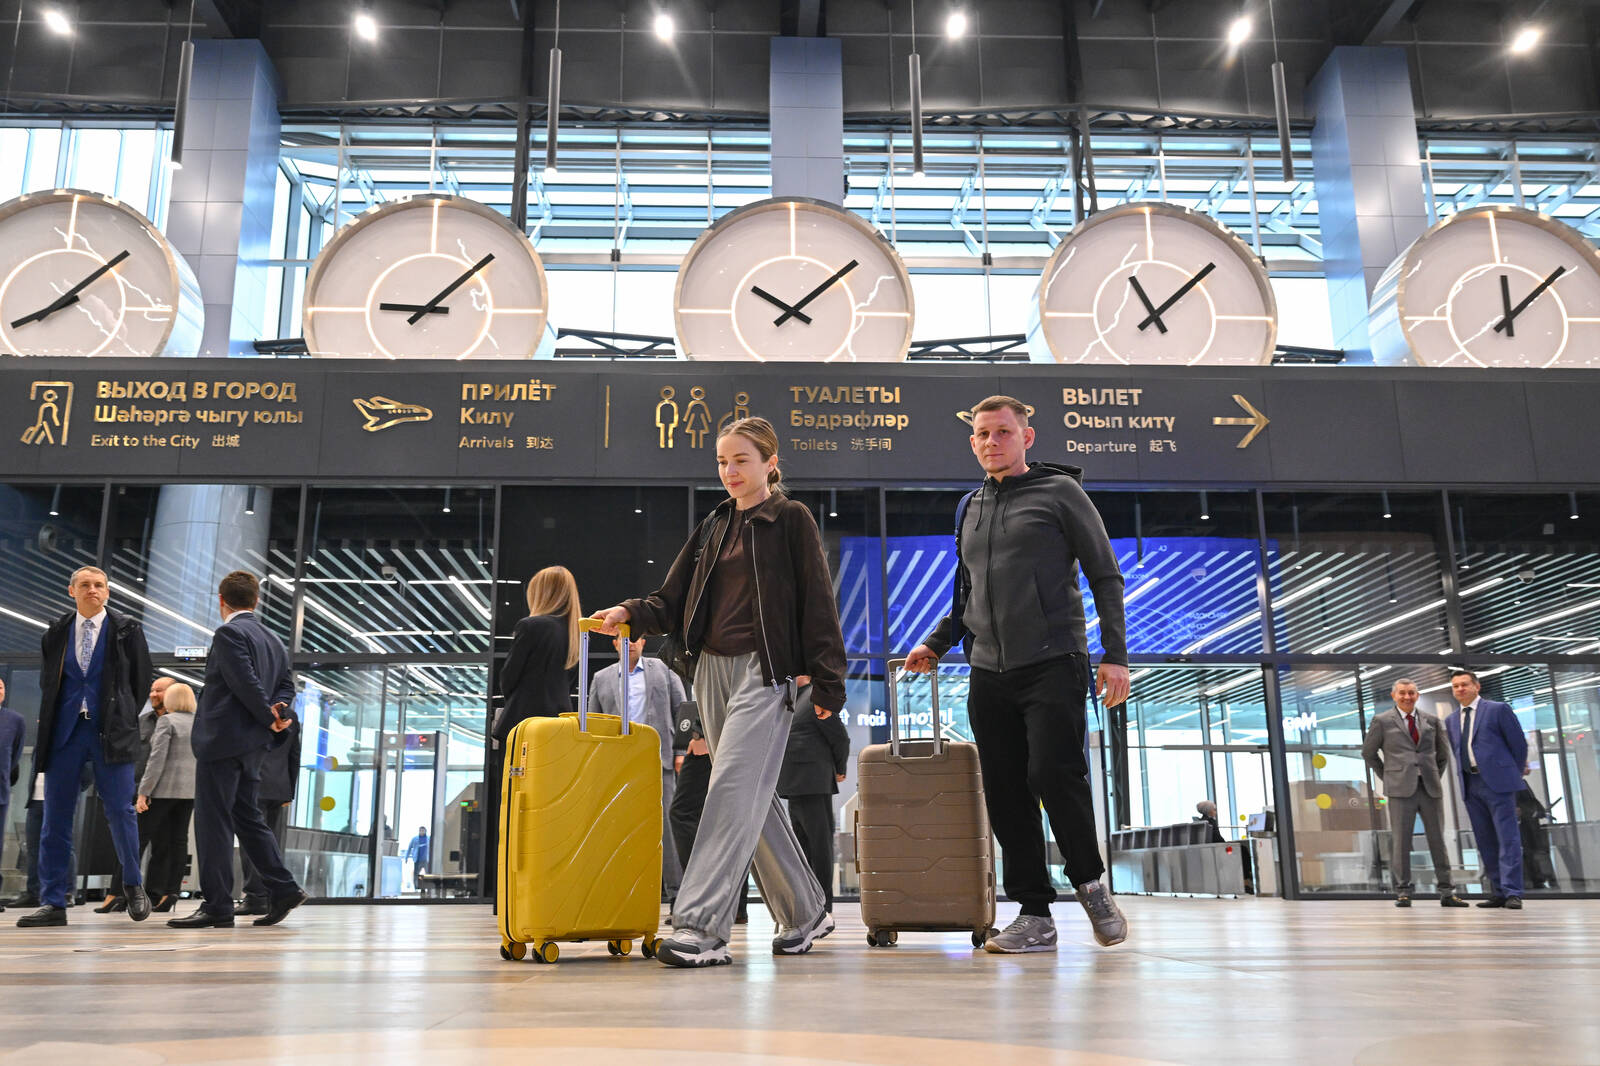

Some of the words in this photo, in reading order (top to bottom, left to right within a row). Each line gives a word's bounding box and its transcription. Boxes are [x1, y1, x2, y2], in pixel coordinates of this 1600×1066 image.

[96, 381, 187, 402] ВЫХОД
[192, 382, 208, 399] В
[212, 382, 297, 402] ГОРОД
[461, 379, 557, 401] ПРИЛЁТ
[789, 386, 901, 403] ТУАЛЕТЫ
[1062, 388, 1143, 406] ВЫЛЕТ
[195, 410, 249, 427] чыгу
[253, 410, 304, 424] юлы
[790, 409, 910, 431] Бәдрәфләр
[1063, 411, 1123, 429] Очып
[90, 434, 120, 447] Exit
[122, 434, 140, 447] to
[142, 434, 167, 447] the
[170, 434, 200, 449] City
[211, 434, 241, 448] 出城
[458, 435, 514, 449] Arrivals
[525, 436, 555, 450] 到达
[791, 438, 838, 451] Toilets
[849, 438, 893, 451] 洗手间
[1066, 439, 1137, 455] Departure
[1149, 439, 1177, 453] 起飞
